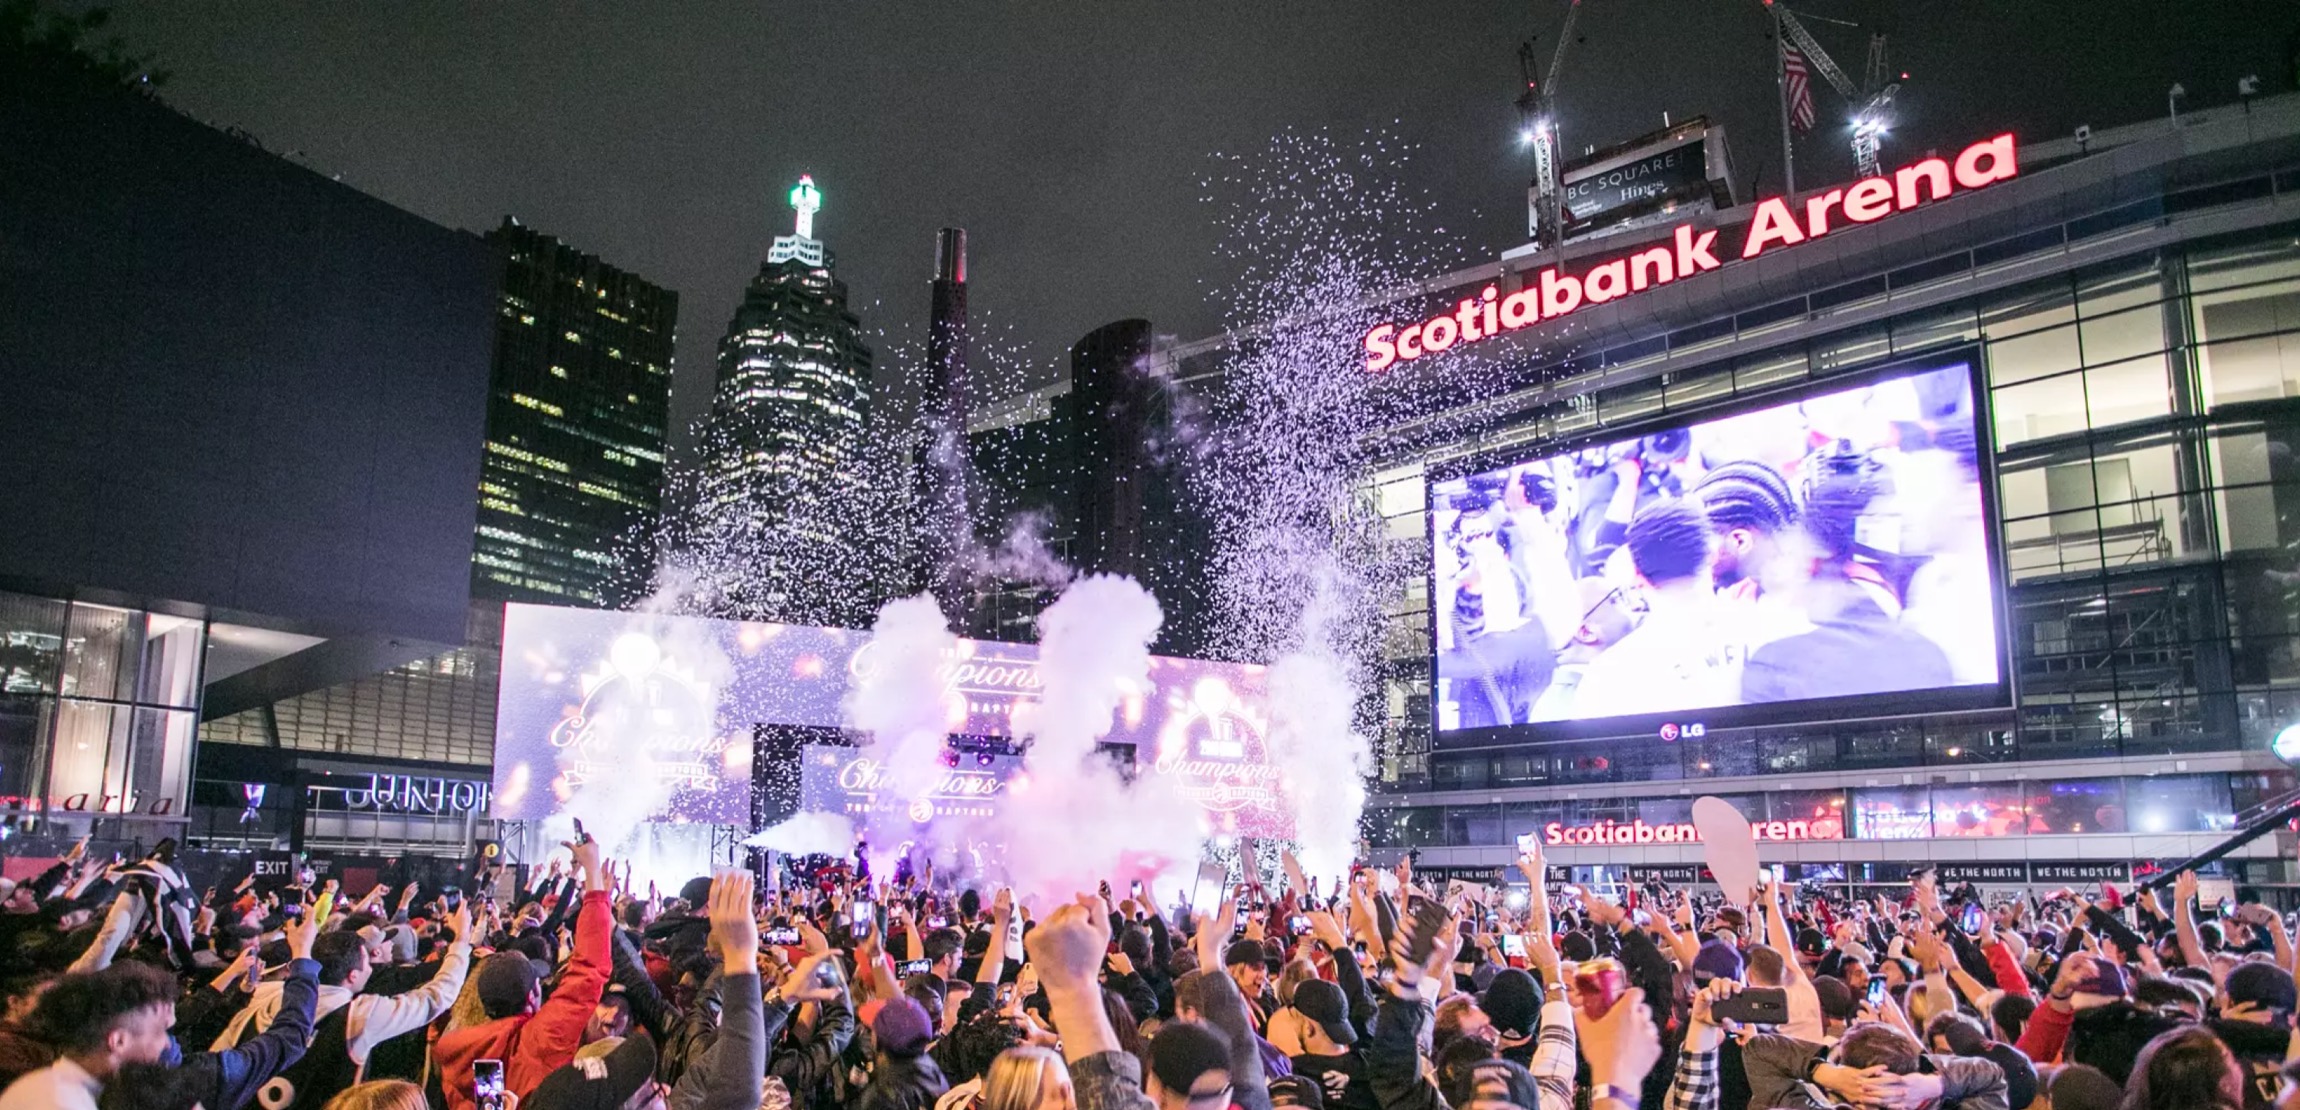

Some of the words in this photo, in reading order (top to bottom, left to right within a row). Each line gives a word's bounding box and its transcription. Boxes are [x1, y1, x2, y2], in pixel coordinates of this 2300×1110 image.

[1598, 153, 1675, 190] SQUARE
[1364, 224, 1721, 371] Scotiabank
[1743, 132, 2019, 259] Arena
[1681, 723, 1706, 738] LG
[63, 789, 174, 816] aria
[1752, 819, 1844, 841] rena
[255, 861, 289, 875] EXIT
[1461, 870, 1474, 878] THE
[1475, 870, 1497, 879] NORT
[1550, 869, 1566, 880] THE
[1634, 869, 1645, 878] WE
[1664, 869, 1692, 878] NORTH
[1959, 867, 1980, 877] THE
[1983, 867, 2021, 877] NORTH
[2037, 867, 2051, 877] WE
[2055, 867, 2076, 877] THE
[2079, 867, 2122, 877] NORTH
